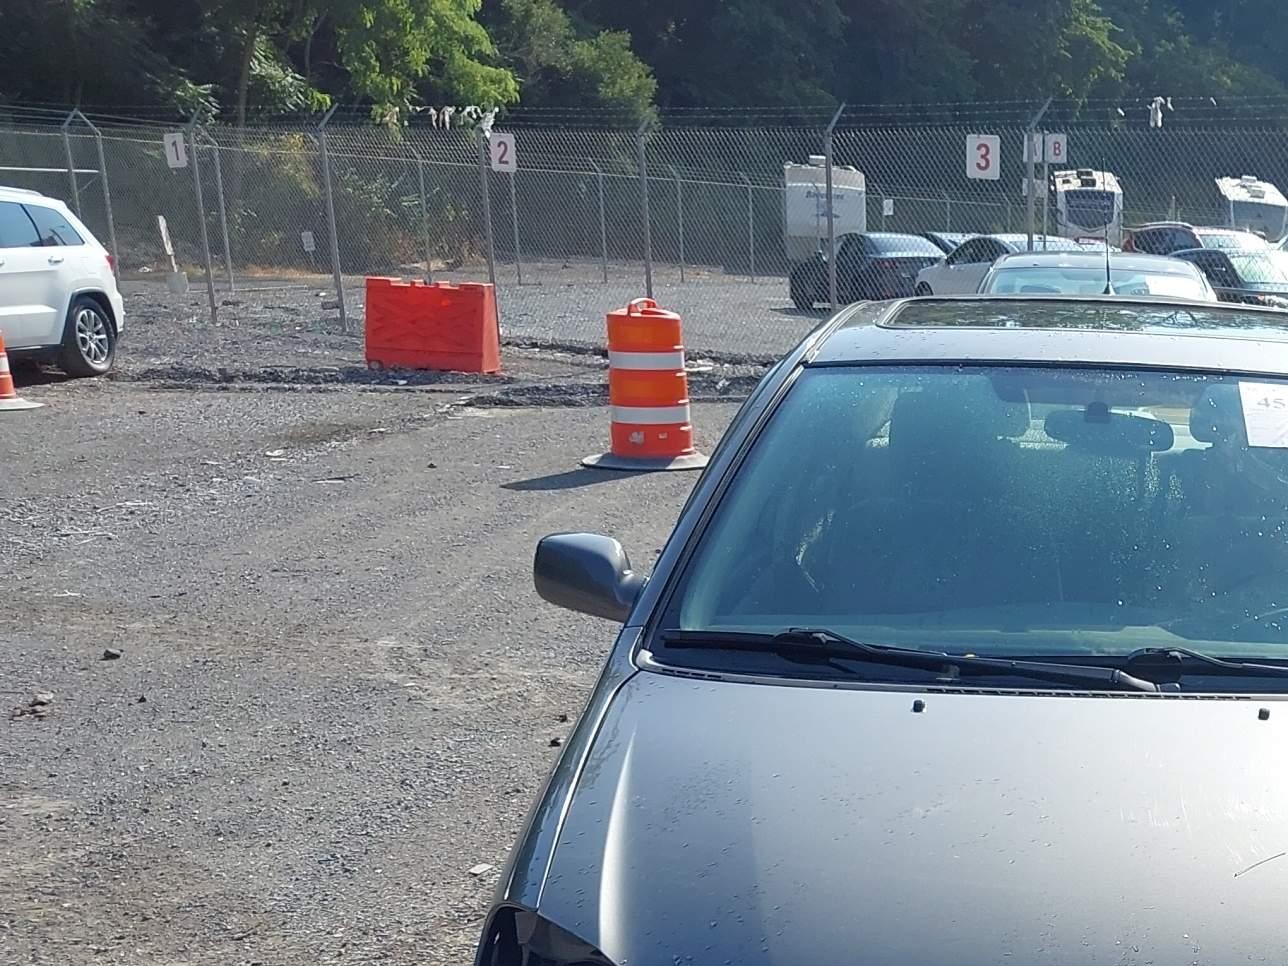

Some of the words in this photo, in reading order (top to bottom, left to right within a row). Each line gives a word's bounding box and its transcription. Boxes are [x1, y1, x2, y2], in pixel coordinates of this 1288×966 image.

[171, 140, 180, 161] 1
[497, 141, 509, 164] 2
[976, 143, 990, 171] 3
[1053, 141, 1061, 156] B
